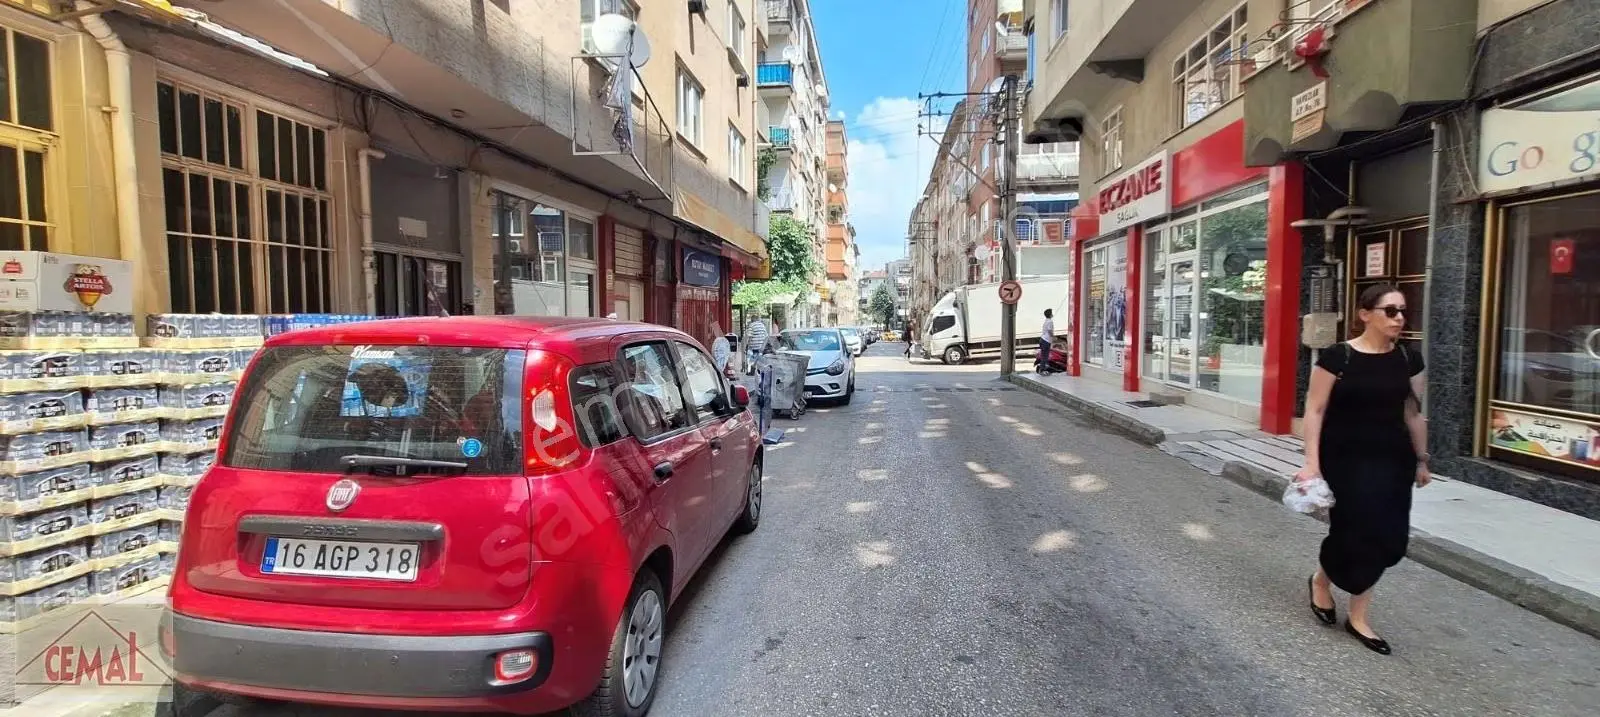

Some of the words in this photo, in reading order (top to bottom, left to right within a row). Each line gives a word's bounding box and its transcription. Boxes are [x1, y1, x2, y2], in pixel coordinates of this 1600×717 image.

[1099, 160, 1162, 214] ECZANE
[332, 487, 352, 501] FIAT
[265, 556, 275, 565] TR
[282, 543, 306, 569] 16
[314, 543, 360, 571] AGP
[365, 547, 413, 574] 318
